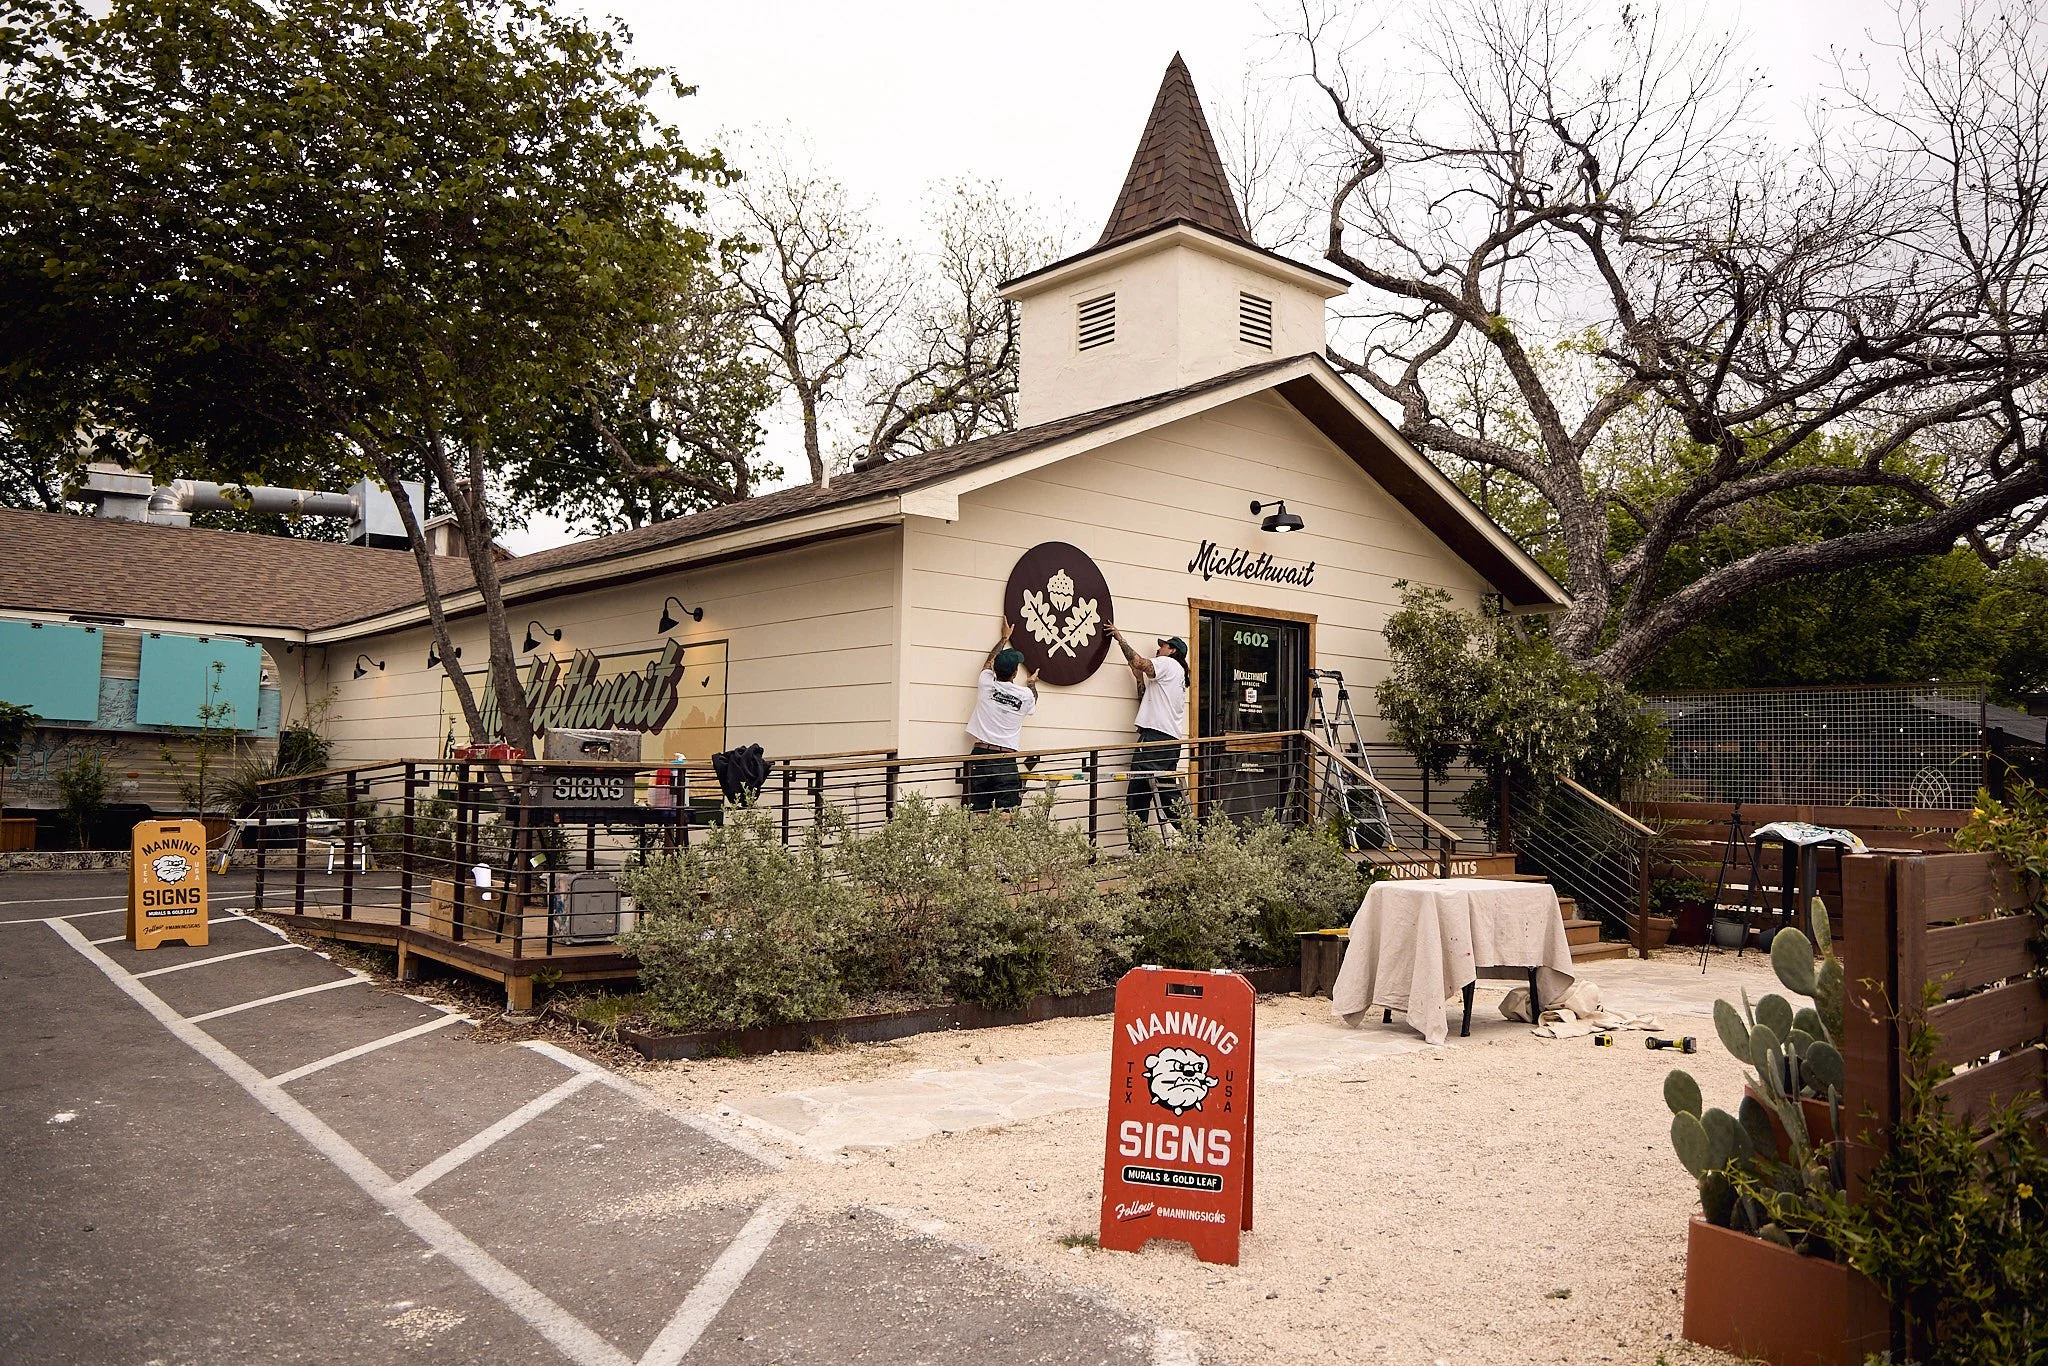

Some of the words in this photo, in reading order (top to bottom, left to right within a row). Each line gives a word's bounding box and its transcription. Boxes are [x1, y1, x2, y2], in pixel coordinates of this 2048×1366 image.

[1187, 539, 1316, 588] Micklethwait
[1233, 630, 1269, 648] 4602
[478, 637, 685, 743] Mklethwait
[554, 775, 625, 801] SIGNS
[141, 839, 200, 857] MANNING
[1432, 861, 1478, 877] AAITS
[142, 887, 201, 907] SIGNS
[1125, 1011, 1239, 1055] MANNING
[1124, 1061, 1135, 1104] TEX
[1223, 1069, 1234, 1113] USA
[1119, 1120, 1232, 1166] SIGNS
[1128, 1169, 1161, 1182] MURALS
[1163, 1173, 1170, 1182] &
[1172, 1174, 1195, 1185] GOLD
[1196, 1177, 1218, 1188] LEAF
[1115, 1200, 1155, 1220] Follow
[1156, 1206, 1226, 1223] @MANNINGSIGNS
